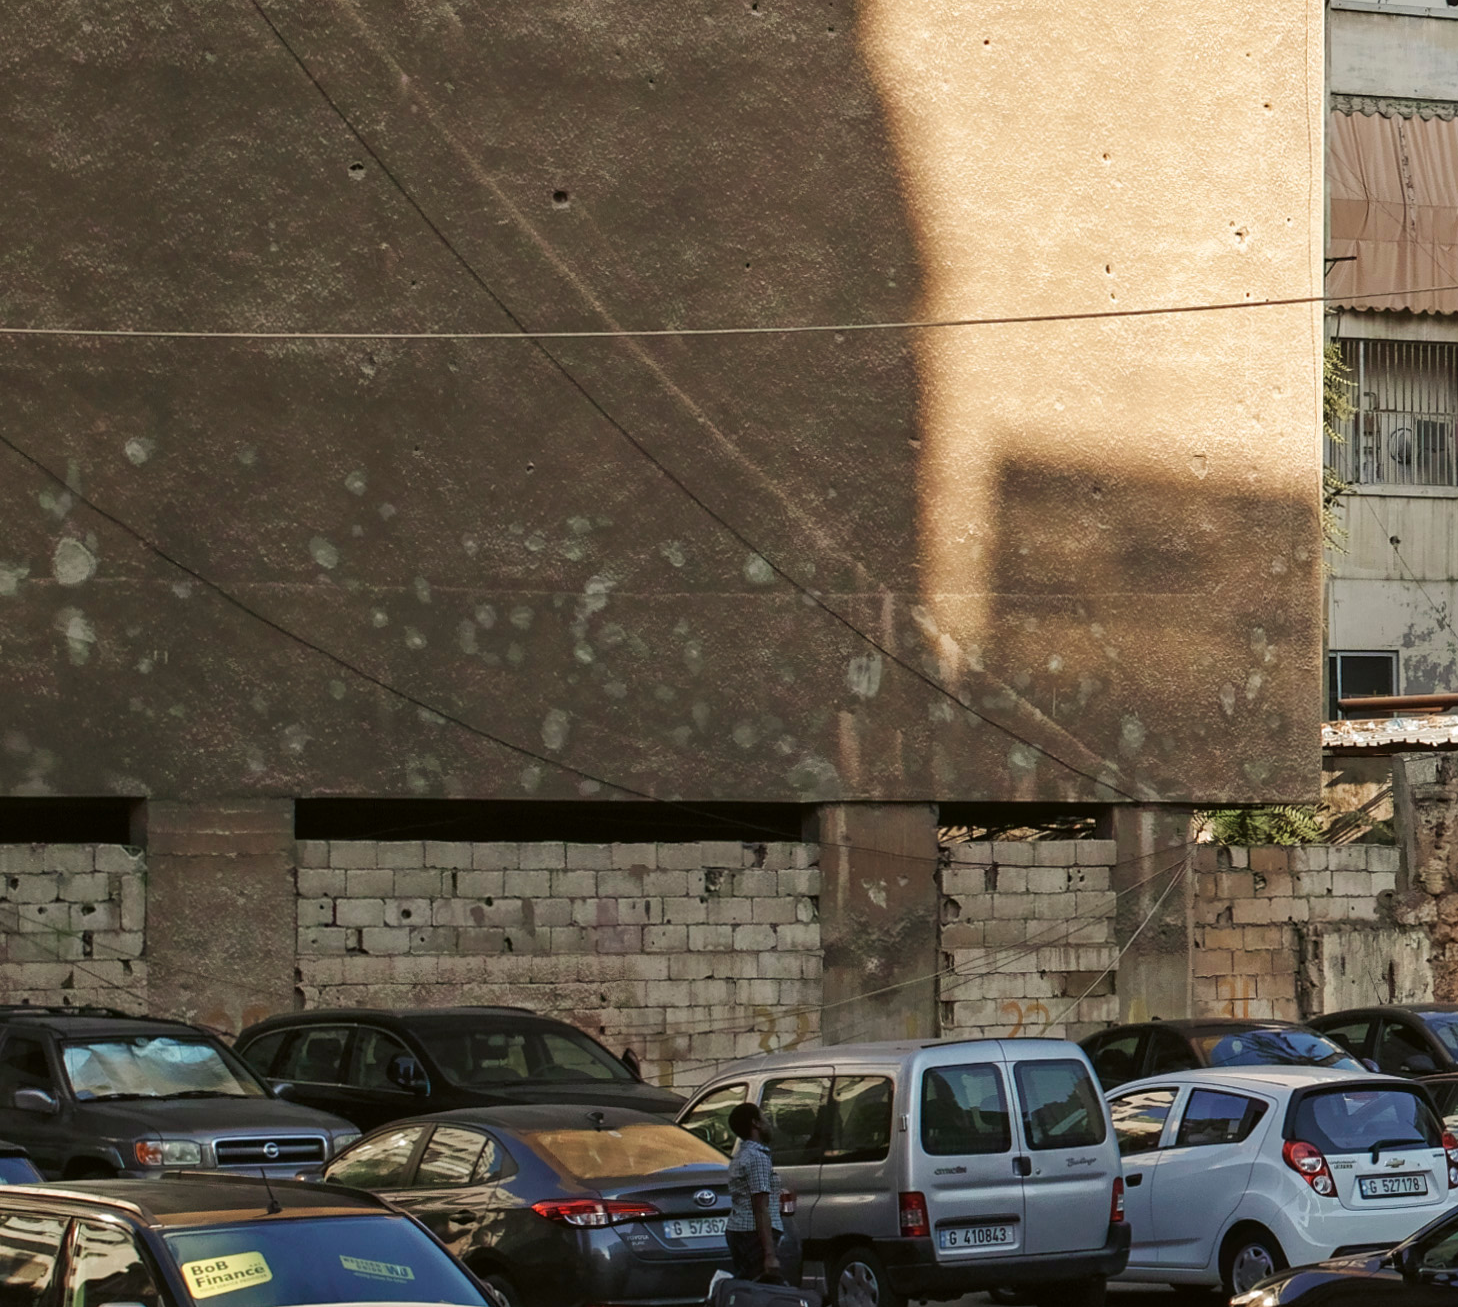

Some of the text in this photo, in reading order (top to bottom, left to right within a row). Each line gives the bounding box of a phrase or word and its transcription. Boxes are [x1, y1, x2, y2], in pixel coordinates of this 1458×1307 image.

[1370, 1177, 1421, 1194] G 527178
[673, 1221, 683, 1235] G
[948, 1227, 1007, 1246] G 410843
[191, 1261, 229, 1276] BoB
[195, 1265, 266, 1288] Finance
